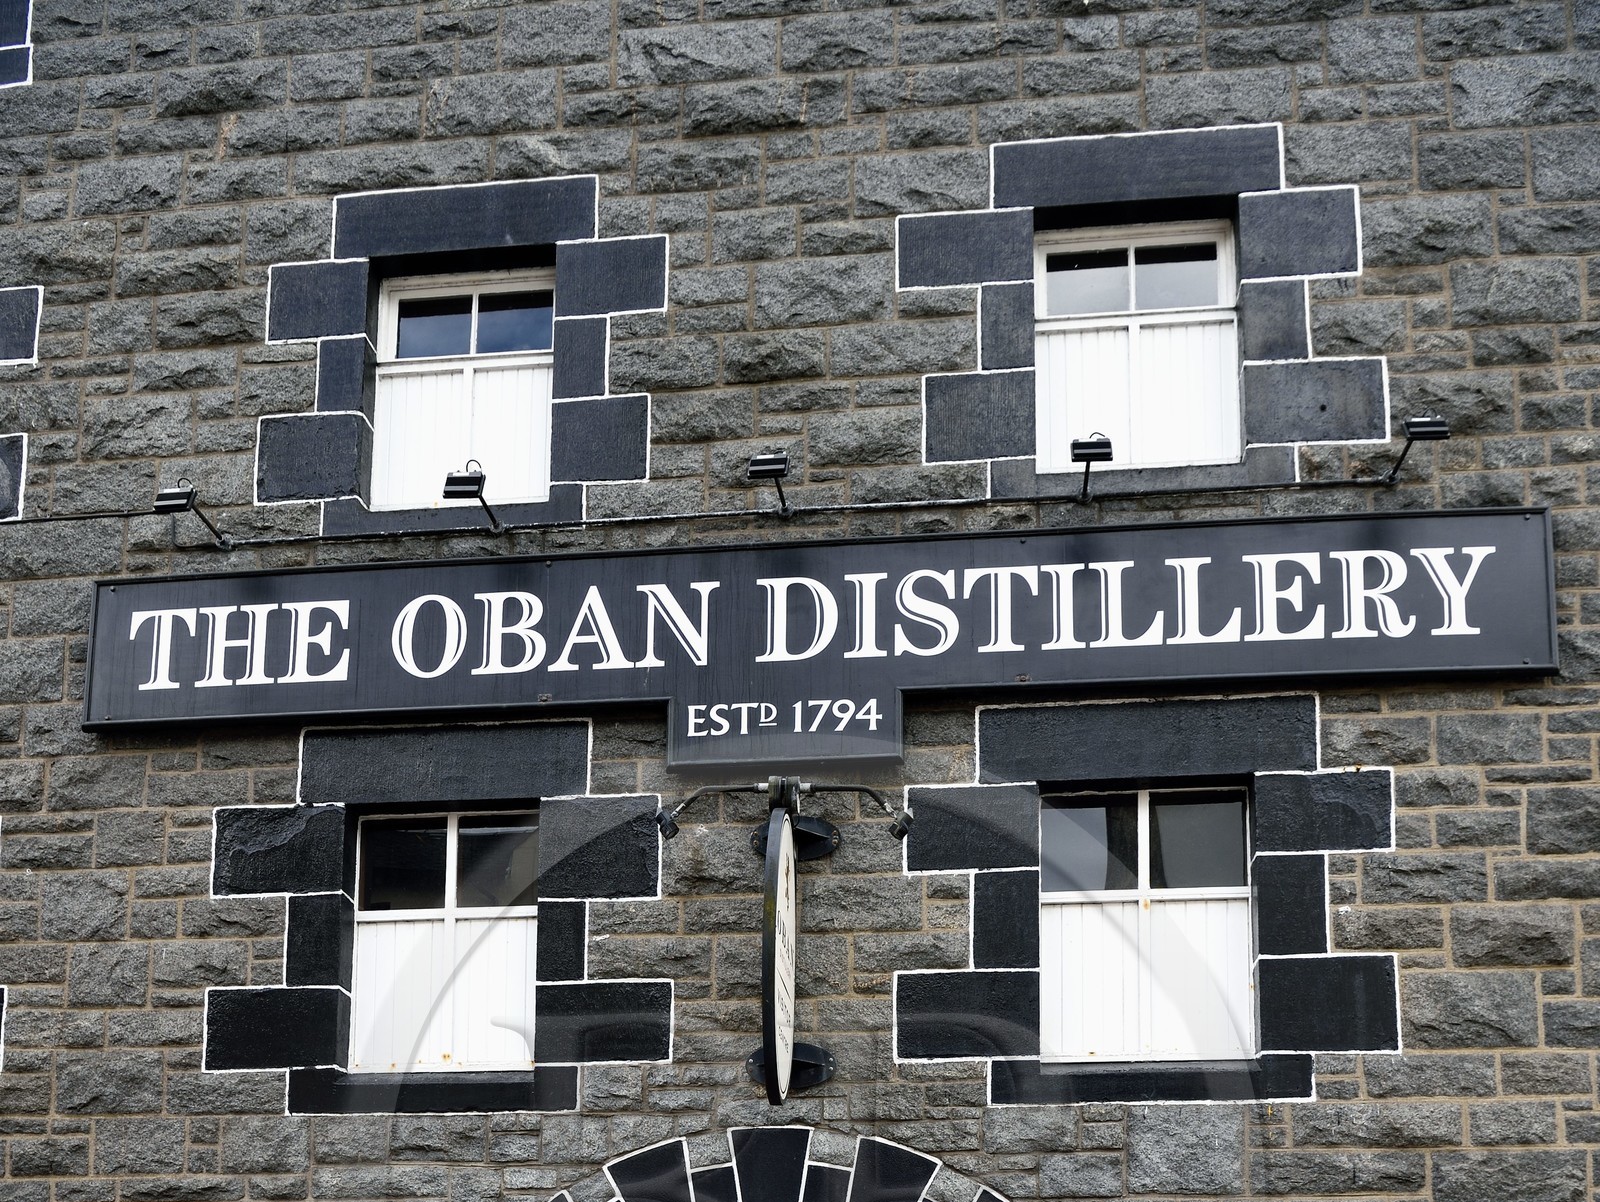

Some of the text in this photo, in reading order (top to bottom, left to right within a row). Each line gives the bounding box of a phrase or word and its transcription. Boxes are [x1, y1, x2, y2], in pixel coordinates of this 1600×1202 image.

[130, 546, 1496, 690] THE OBAN DISTILLERY
[792, 699, 883, 733] 1794
